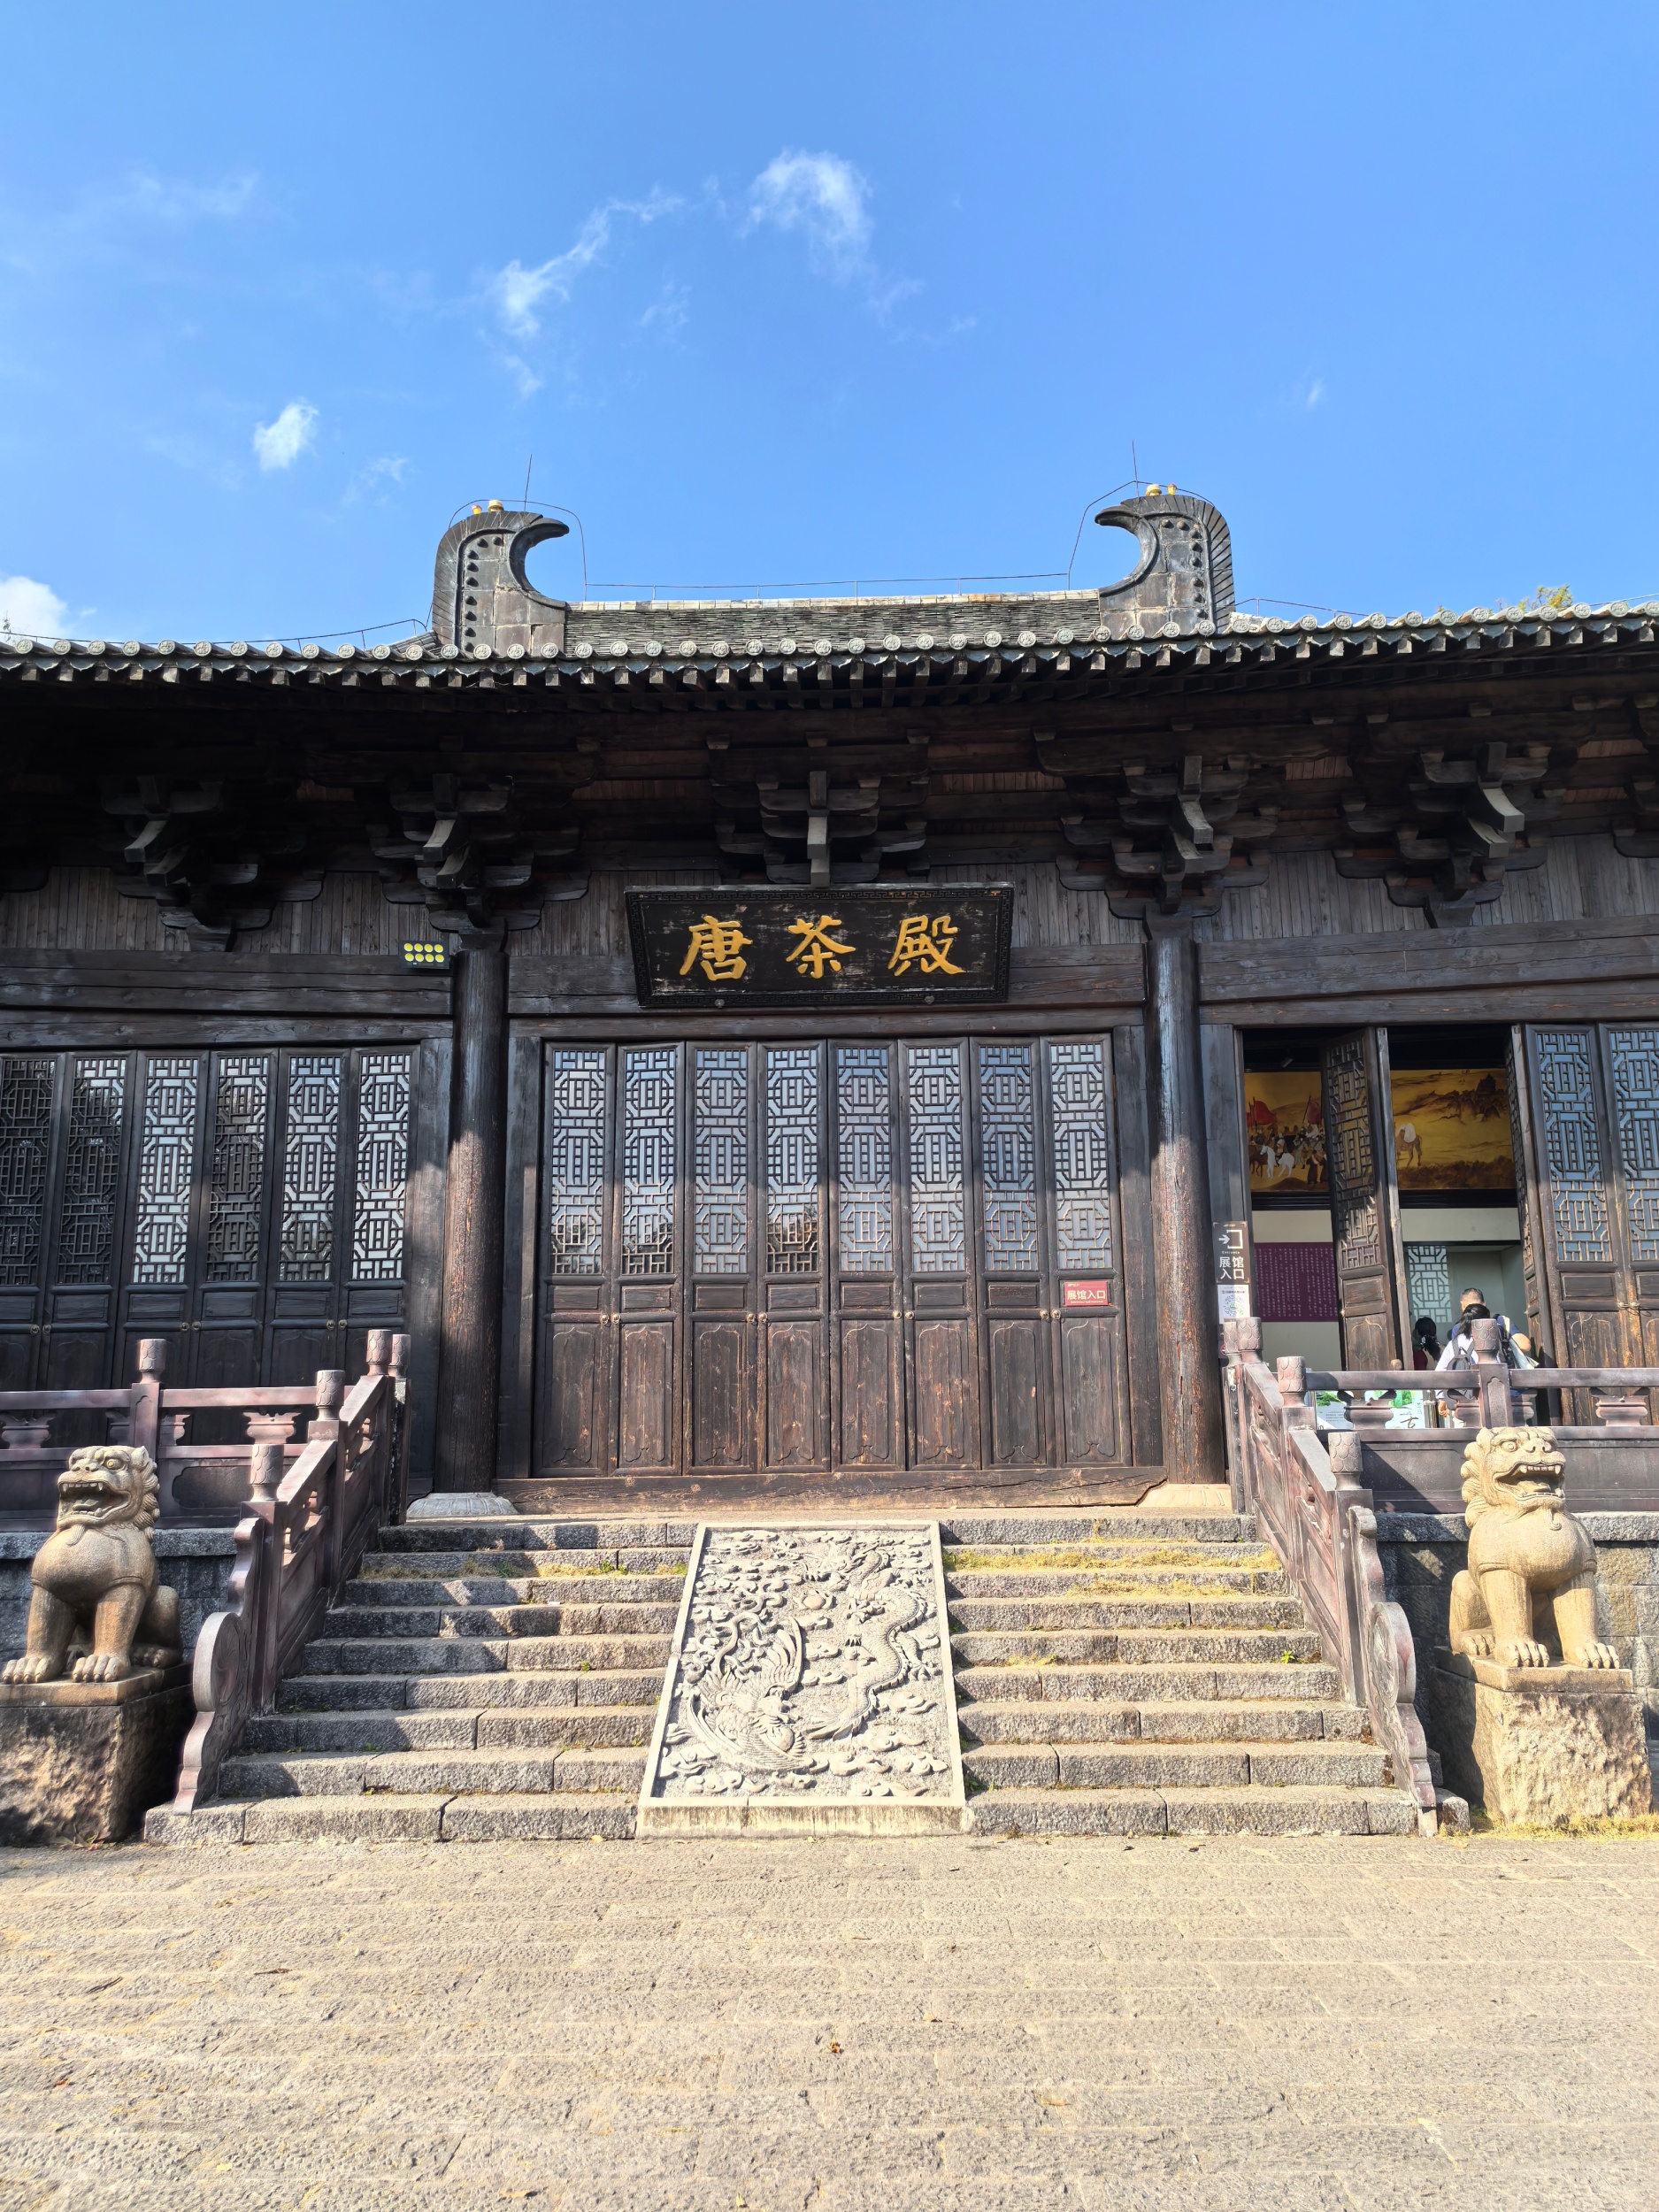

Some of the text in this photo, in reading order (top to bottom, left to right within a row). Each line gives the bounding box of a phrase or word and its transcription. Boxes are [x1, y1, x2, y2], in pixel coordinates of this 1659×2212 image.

[680, 915, 966, 980] 唐茶殿
[1219, 1256, 1244, 1268] 展馆
[1220, 1268, 1245, 1279] 入口
[1067, 1289, 1106, 1300] 展馆入口
